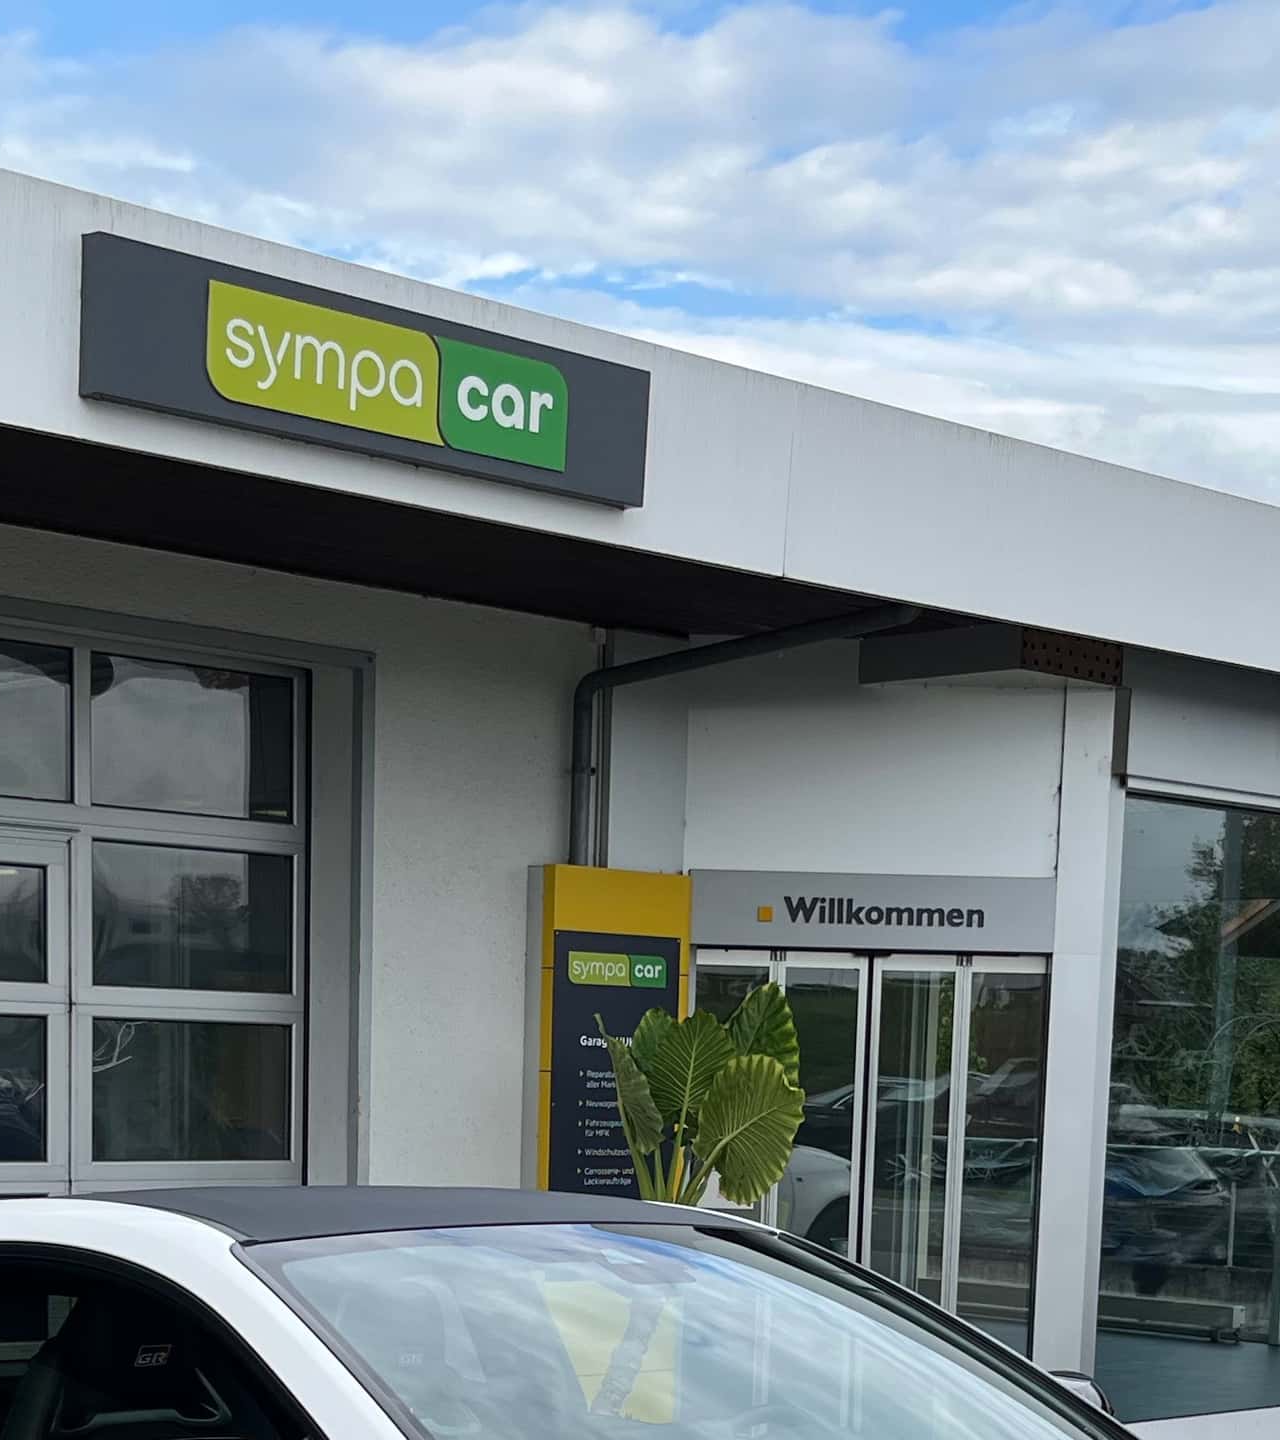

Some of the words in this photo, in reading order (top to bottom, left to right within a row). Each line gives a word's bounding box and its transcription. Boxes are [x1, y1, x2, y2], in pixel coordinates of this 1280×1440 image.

[224, 318, 423, 410] sympa
[457, 375, 553, 433] car
[783, 896, 985, 928] Willkommen
[572, 960, 626, 981] sympa
[634, 964, 662, 979] car
[580, 1035, 608, 1049] Garag
